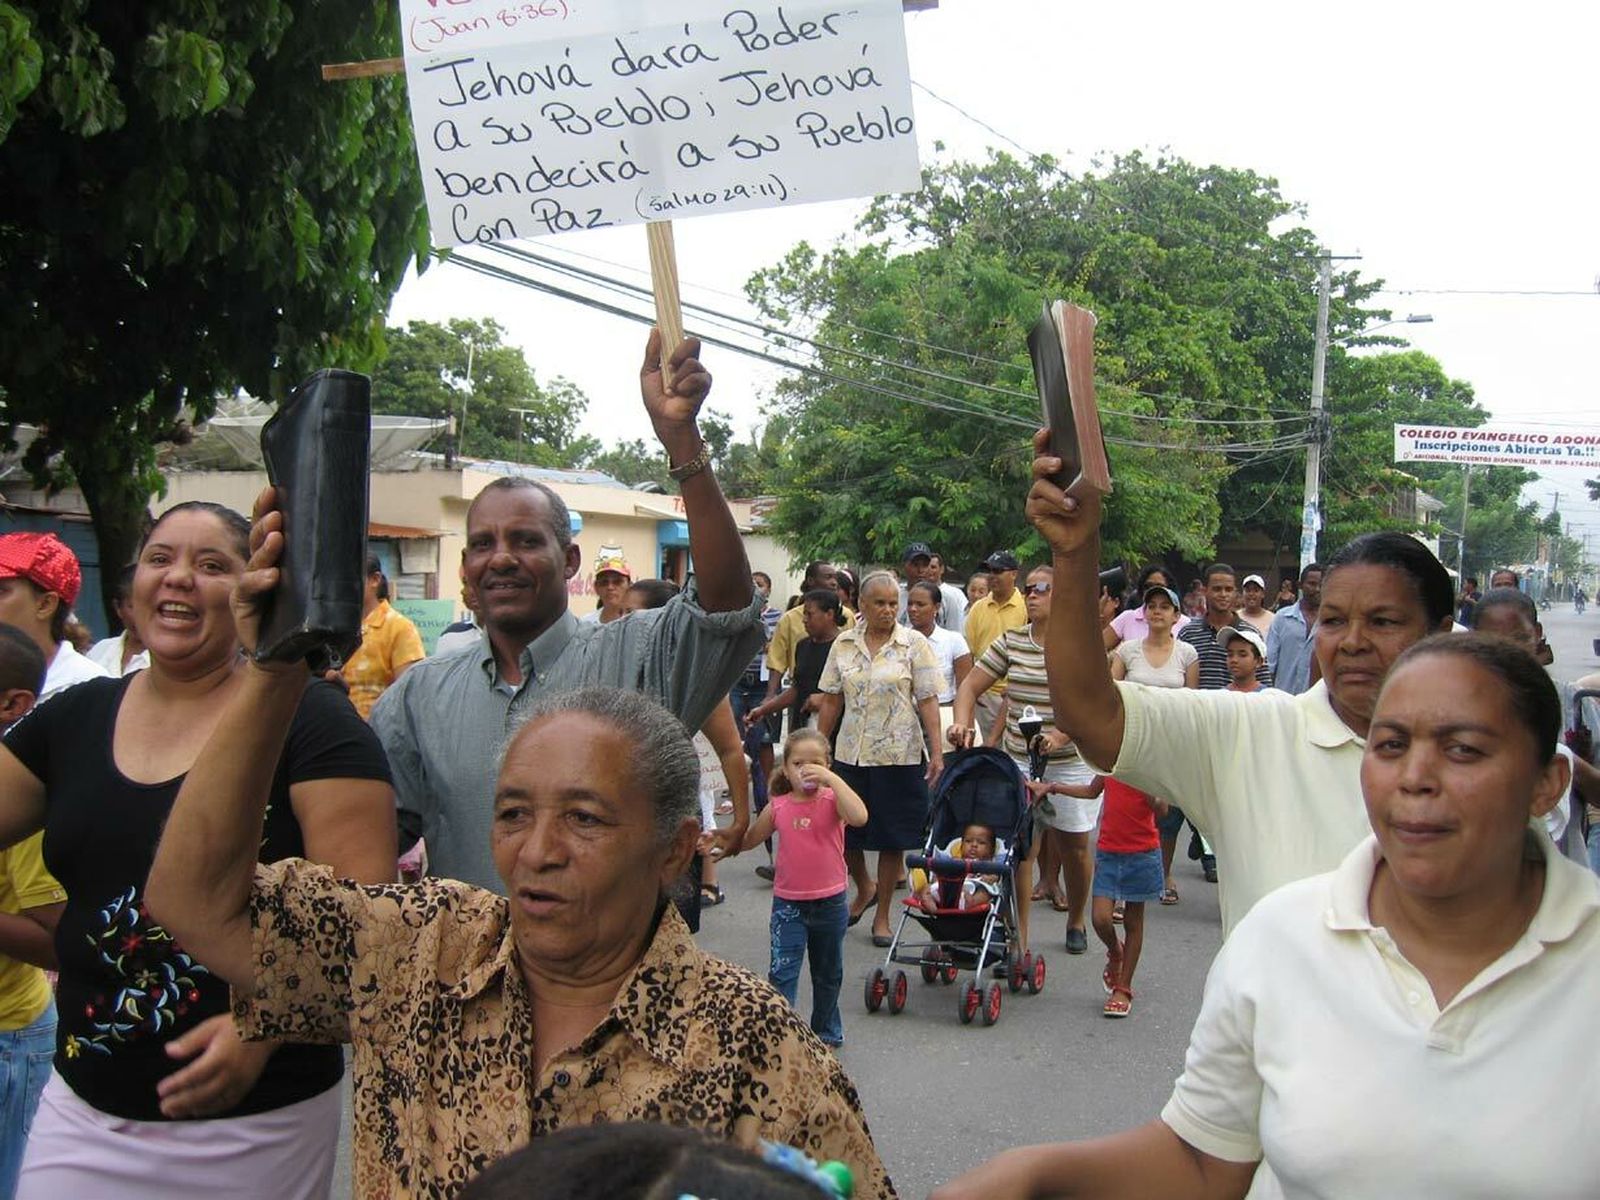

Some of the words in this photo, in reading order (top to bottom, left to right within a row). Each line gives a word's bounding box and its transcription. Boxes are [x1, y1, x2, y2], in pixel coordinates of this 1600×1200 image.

[423, 47, 592, 107] Jehová
[611, 23, 719, 77] dará
[719, 43, 882, 106] Jehová
[435, 140, 649, 198] bendecirá
[796, 105, 913, 149] Pueblo
[452, 203, 518, 245] Con
[1399, 428, 1457, 440] COLEGIO
[1461, 431, 1548, 444] EVANGELICO
[1414, 440, 1501, 453] Inscripciones
[1504, 443, 1562, 455] Abiertas
